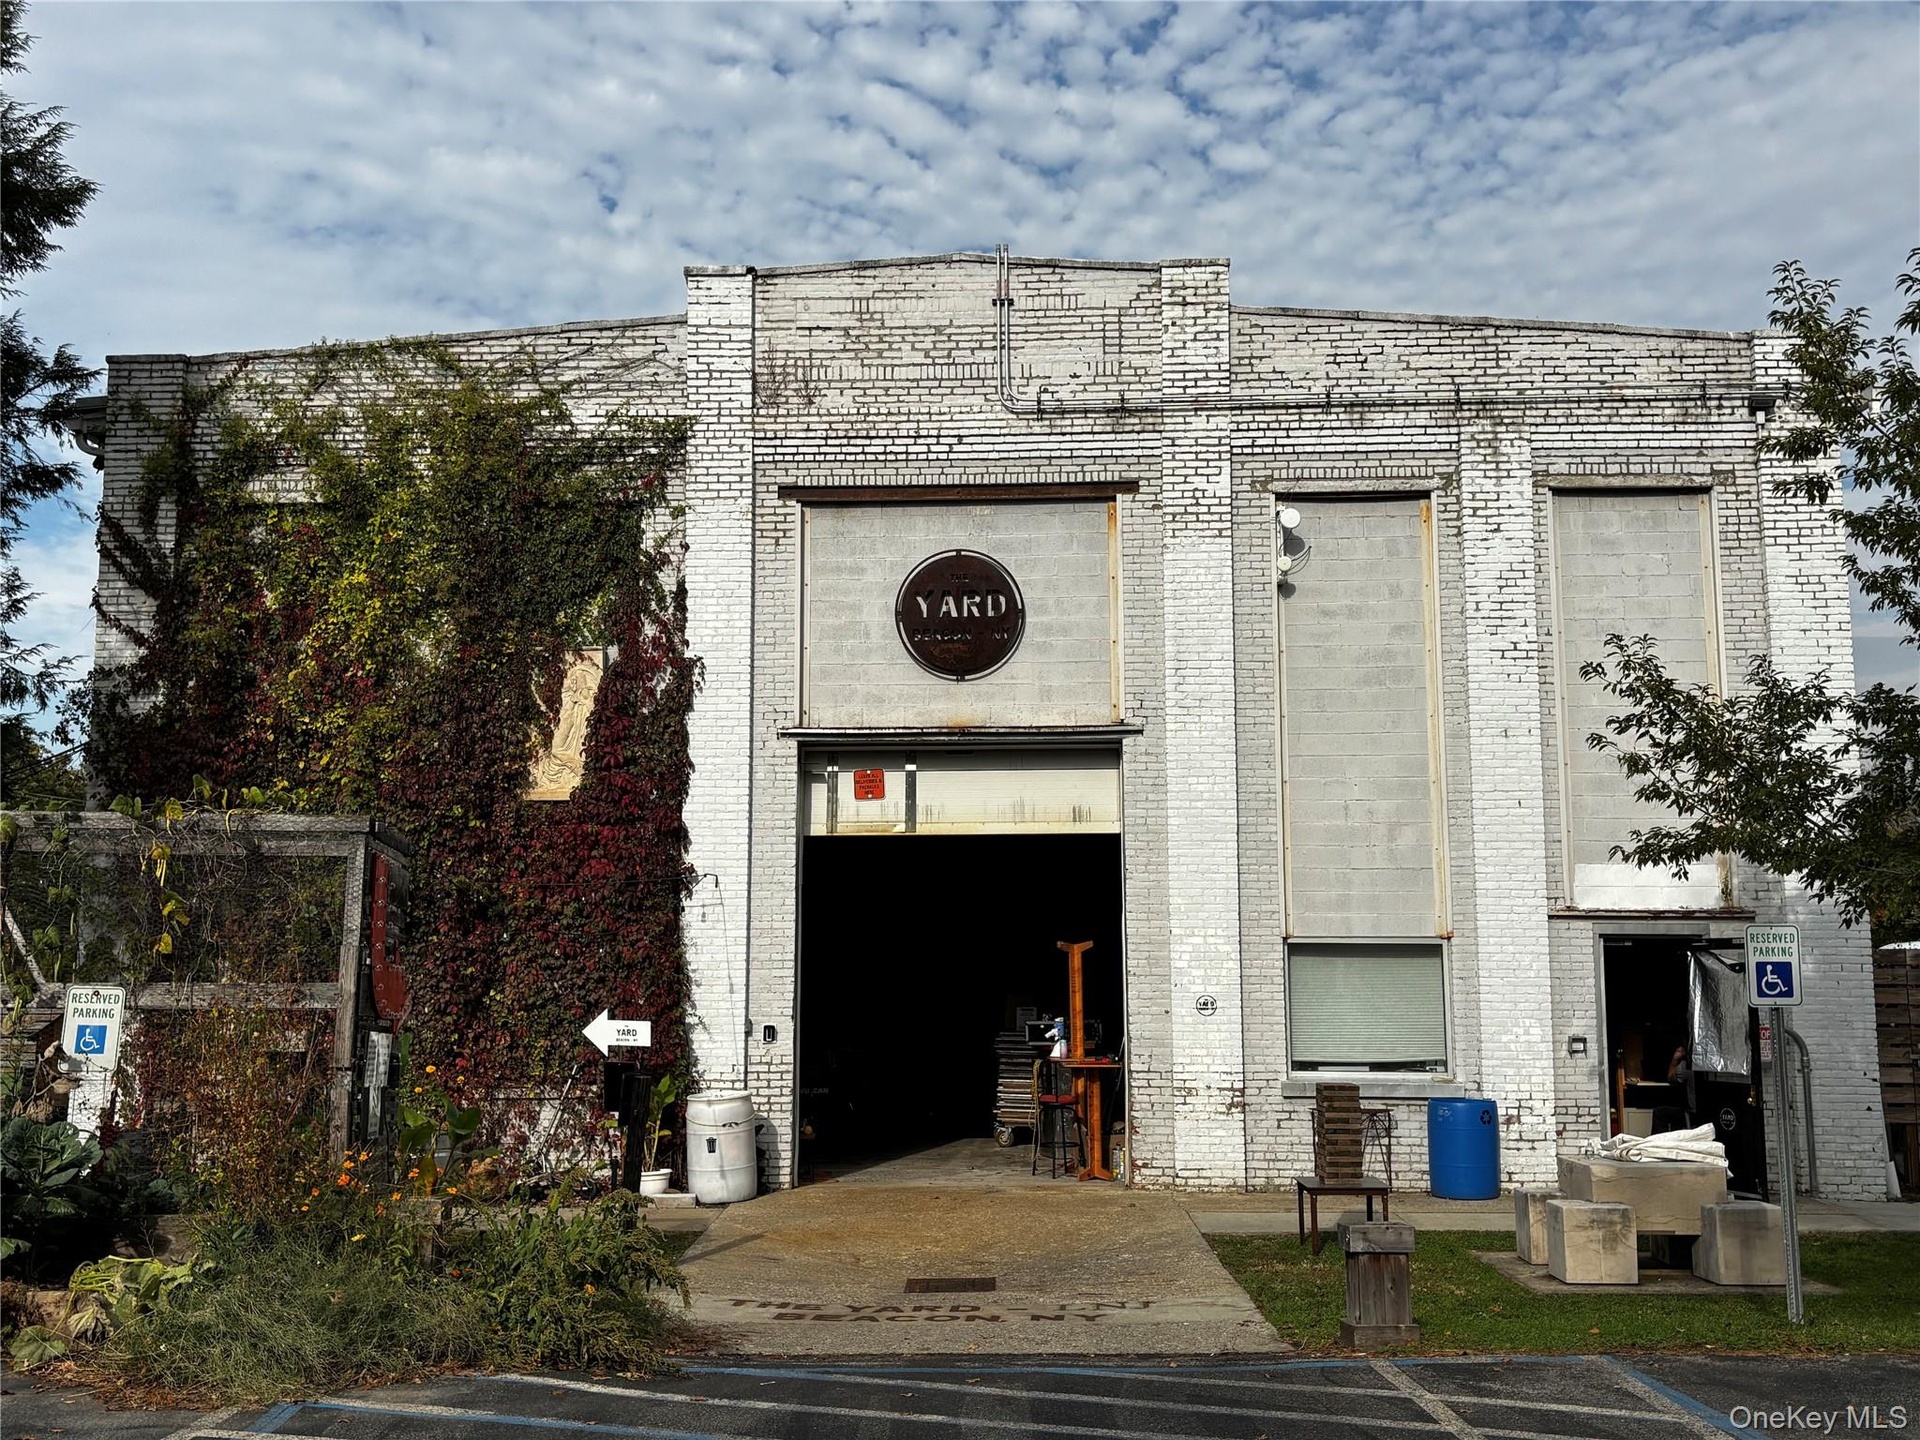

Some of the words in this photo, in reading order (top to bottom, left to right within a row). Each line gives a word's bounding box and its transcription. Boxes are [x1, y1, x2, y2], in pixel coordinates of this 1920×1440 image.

[914, 589, 1006, 618] YARD
[912, 628, 972, 641] BEACON
[991, 627, 1011, 640] NY
[1749, 933, 1796, 944] RESERVED
[1753, 946, 1793, 957] PARKING
[71, 992, 120, 1005] RESERVED
[72, 1007, 115, 1019] PARKING
[728, 1299, 827, 1311] THE
[845, 1304, 981, 1313] YARD
[1030, 1313, 1108, 1322] NY
